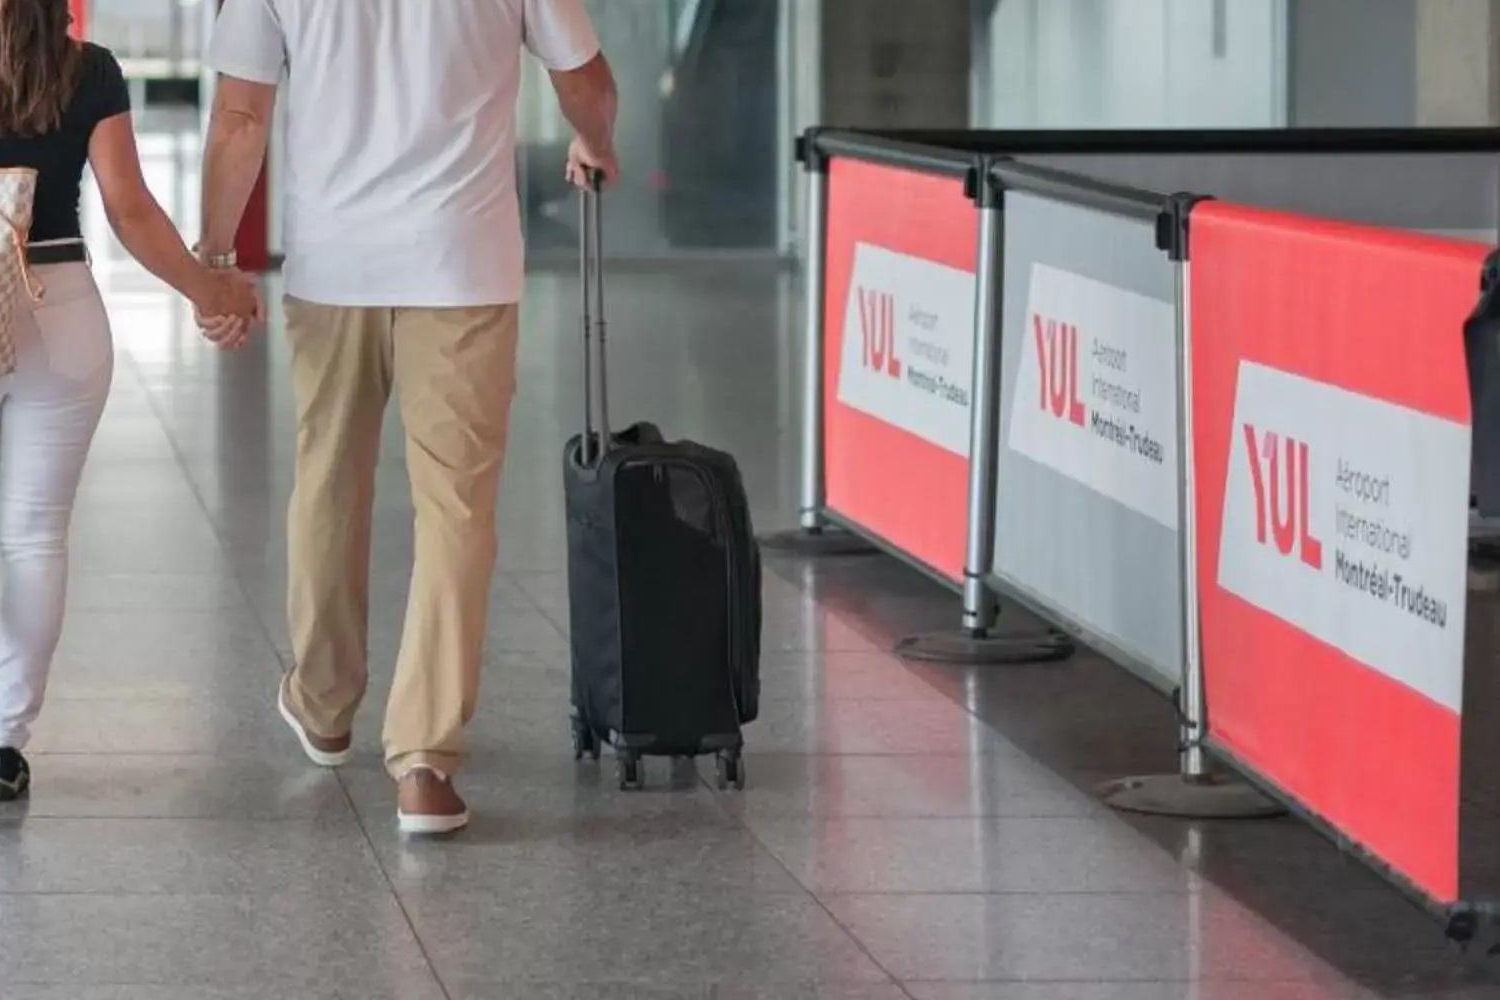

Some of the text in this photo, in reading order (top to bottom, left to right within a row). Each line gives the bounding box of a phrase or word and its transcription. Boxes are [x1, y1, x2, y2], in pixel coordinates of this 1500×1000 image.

[857, 284, 901, 379] YUL
[1033, 313, 1086, 428] YUL
[1244, 423, 1323, 571] YUL
[1335, 547, 1448, 630] Montréal-Trudeau
